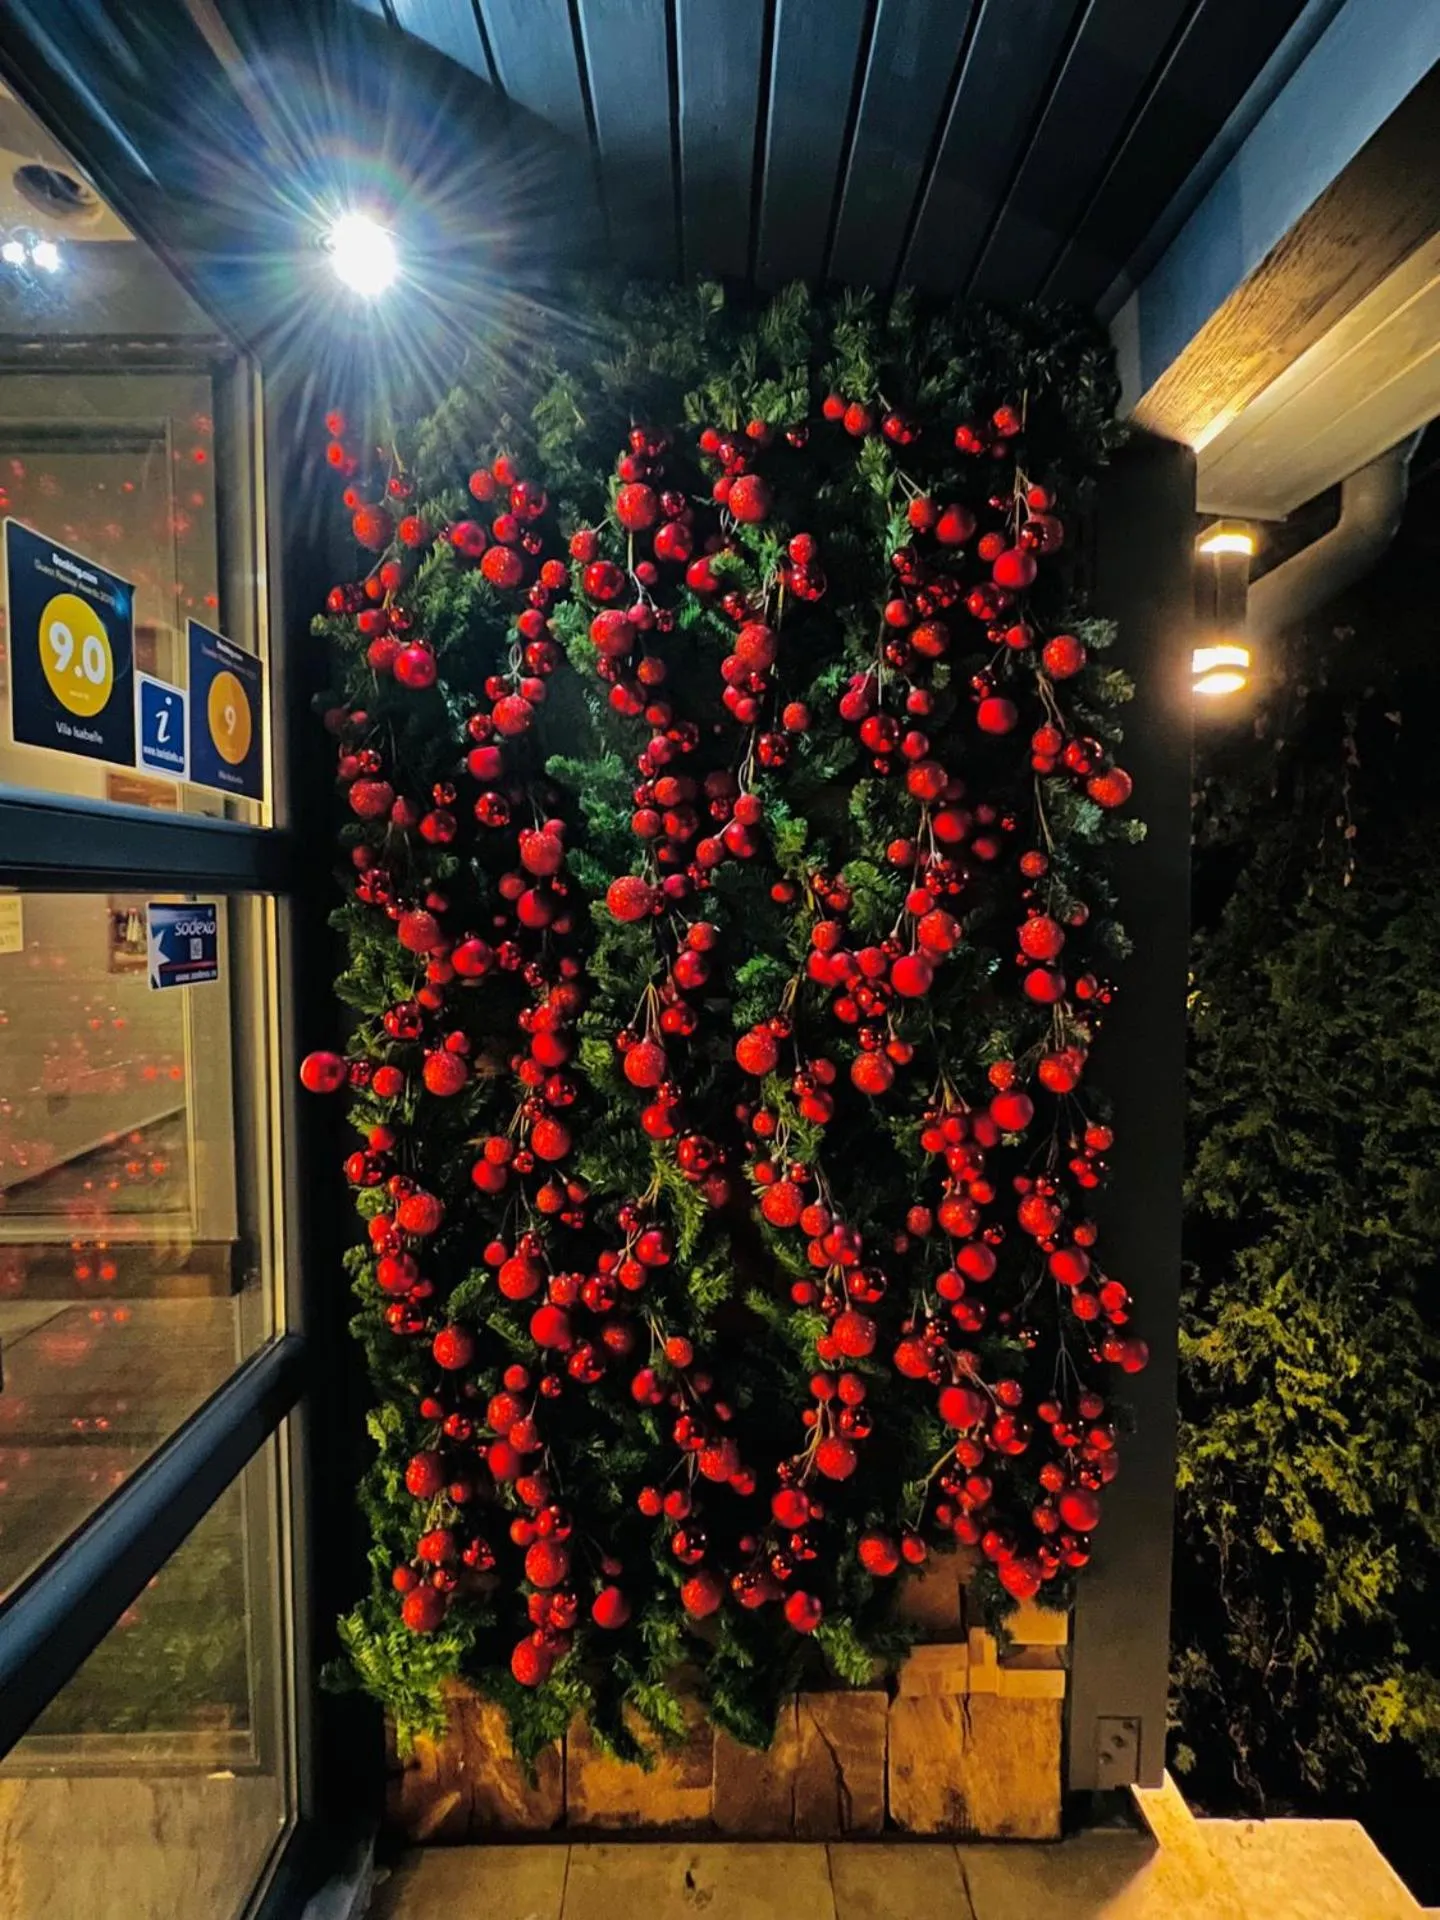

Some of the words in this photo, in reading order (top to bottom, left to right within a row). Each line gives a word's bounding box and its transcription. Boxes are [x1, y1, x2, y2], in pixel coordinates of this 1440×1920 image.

[50, 620, 106, 685] 9.0
[224, 705, 237, 735] 9
[174, 918, 216, 936] sodexo
